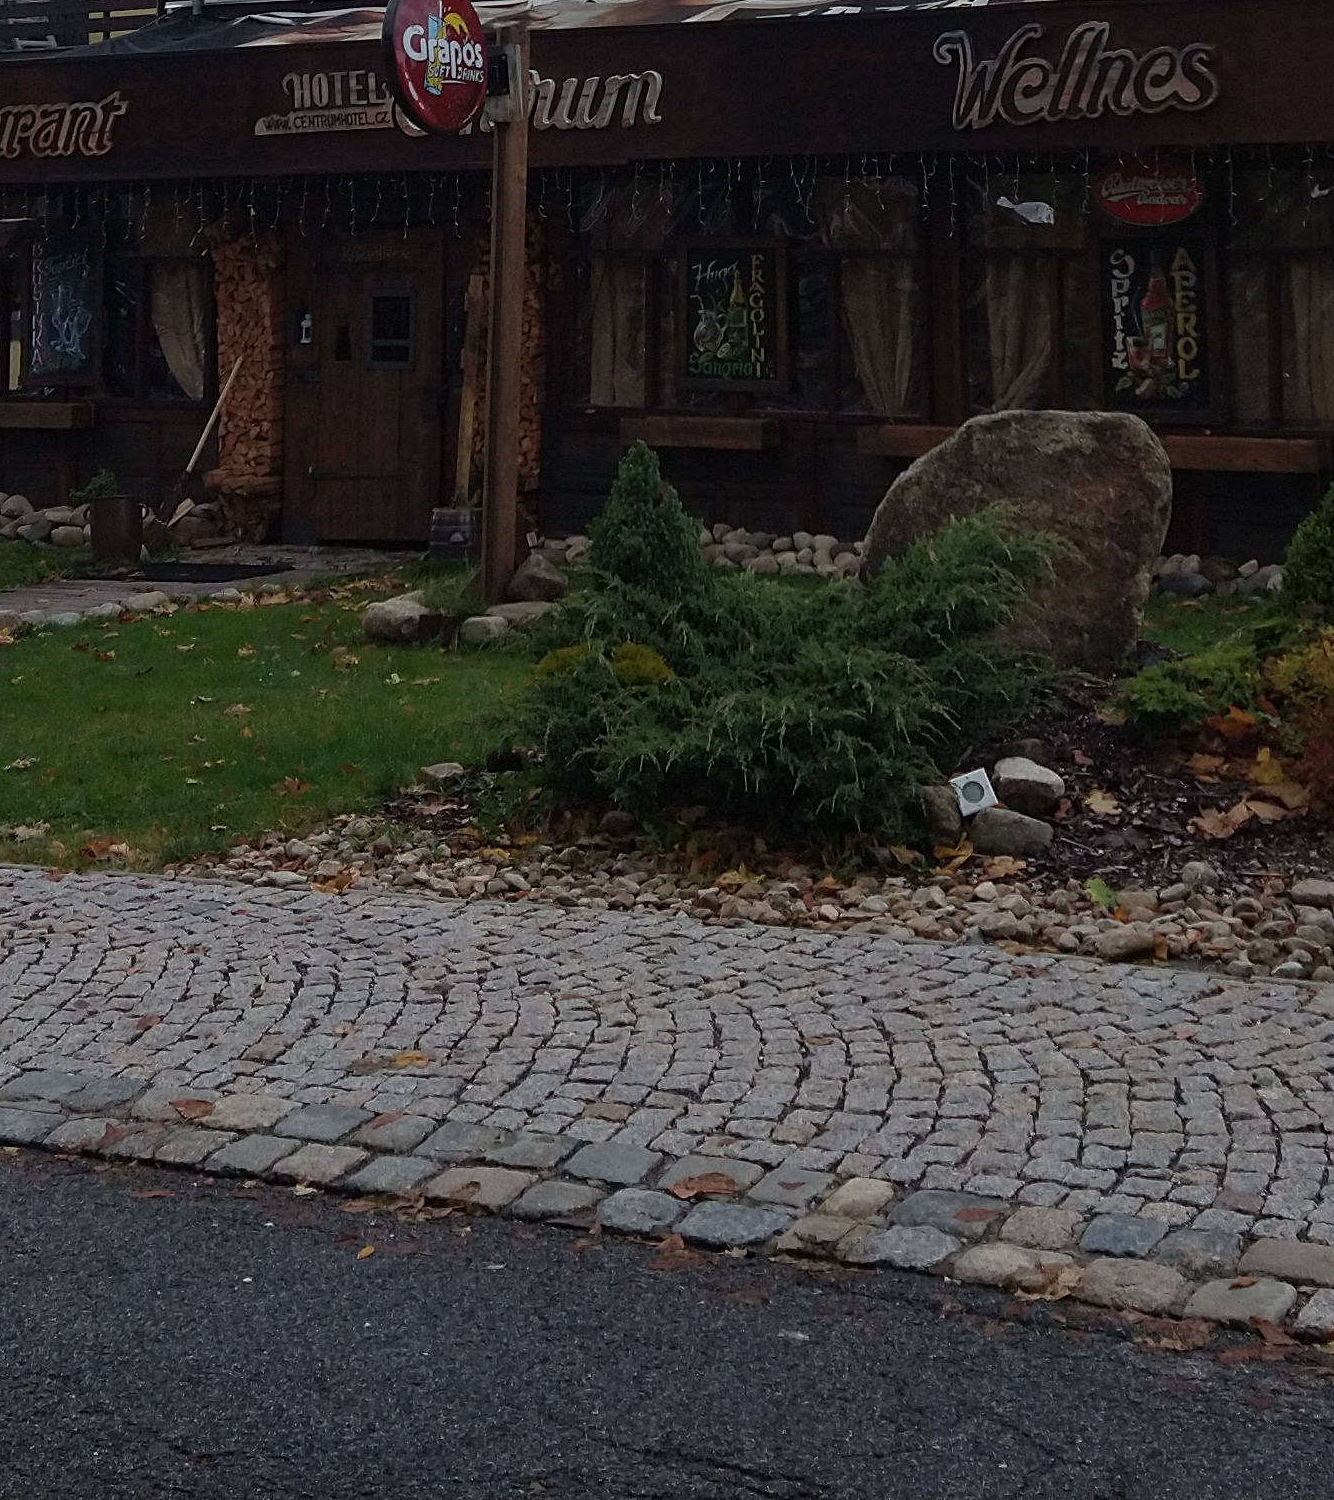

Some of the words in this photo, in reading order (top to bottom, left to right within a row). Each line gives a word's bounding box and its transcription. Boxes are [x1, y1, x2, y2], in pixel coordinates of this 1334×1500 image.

[282, 71, 387, 110] HOTEL
[402, 24, 483, 79] Grapos
[428, 65, 451, 79] SOFT
[456, 66, 485, 83] DRINKS
[932, 19, 1219, 131] Wellnes
[748, 253, 766, 380] FRAGOLINI
[1170, 246, 1201, 380] APEROL
